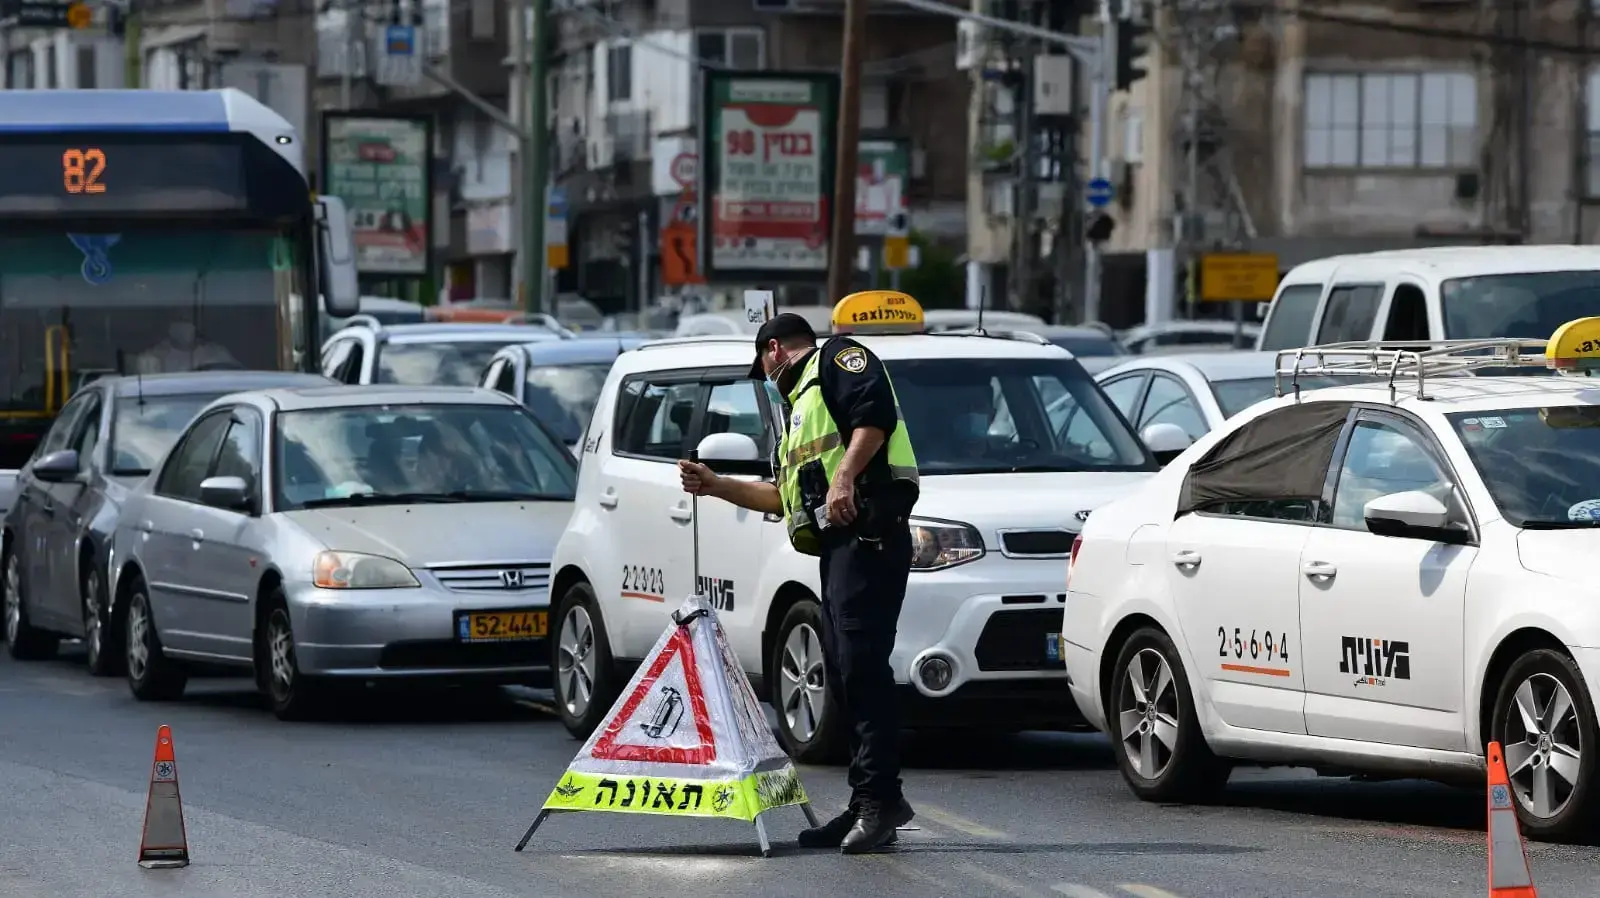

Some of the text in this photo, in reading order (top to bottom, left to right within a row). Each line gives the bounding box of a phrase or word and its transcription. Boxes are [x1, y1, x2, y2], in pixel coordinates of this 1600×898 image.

[63, 148, 106, 193] 82
[852, 306, 883, 322] taxi
[594, 777, 703, 811] תאונה
